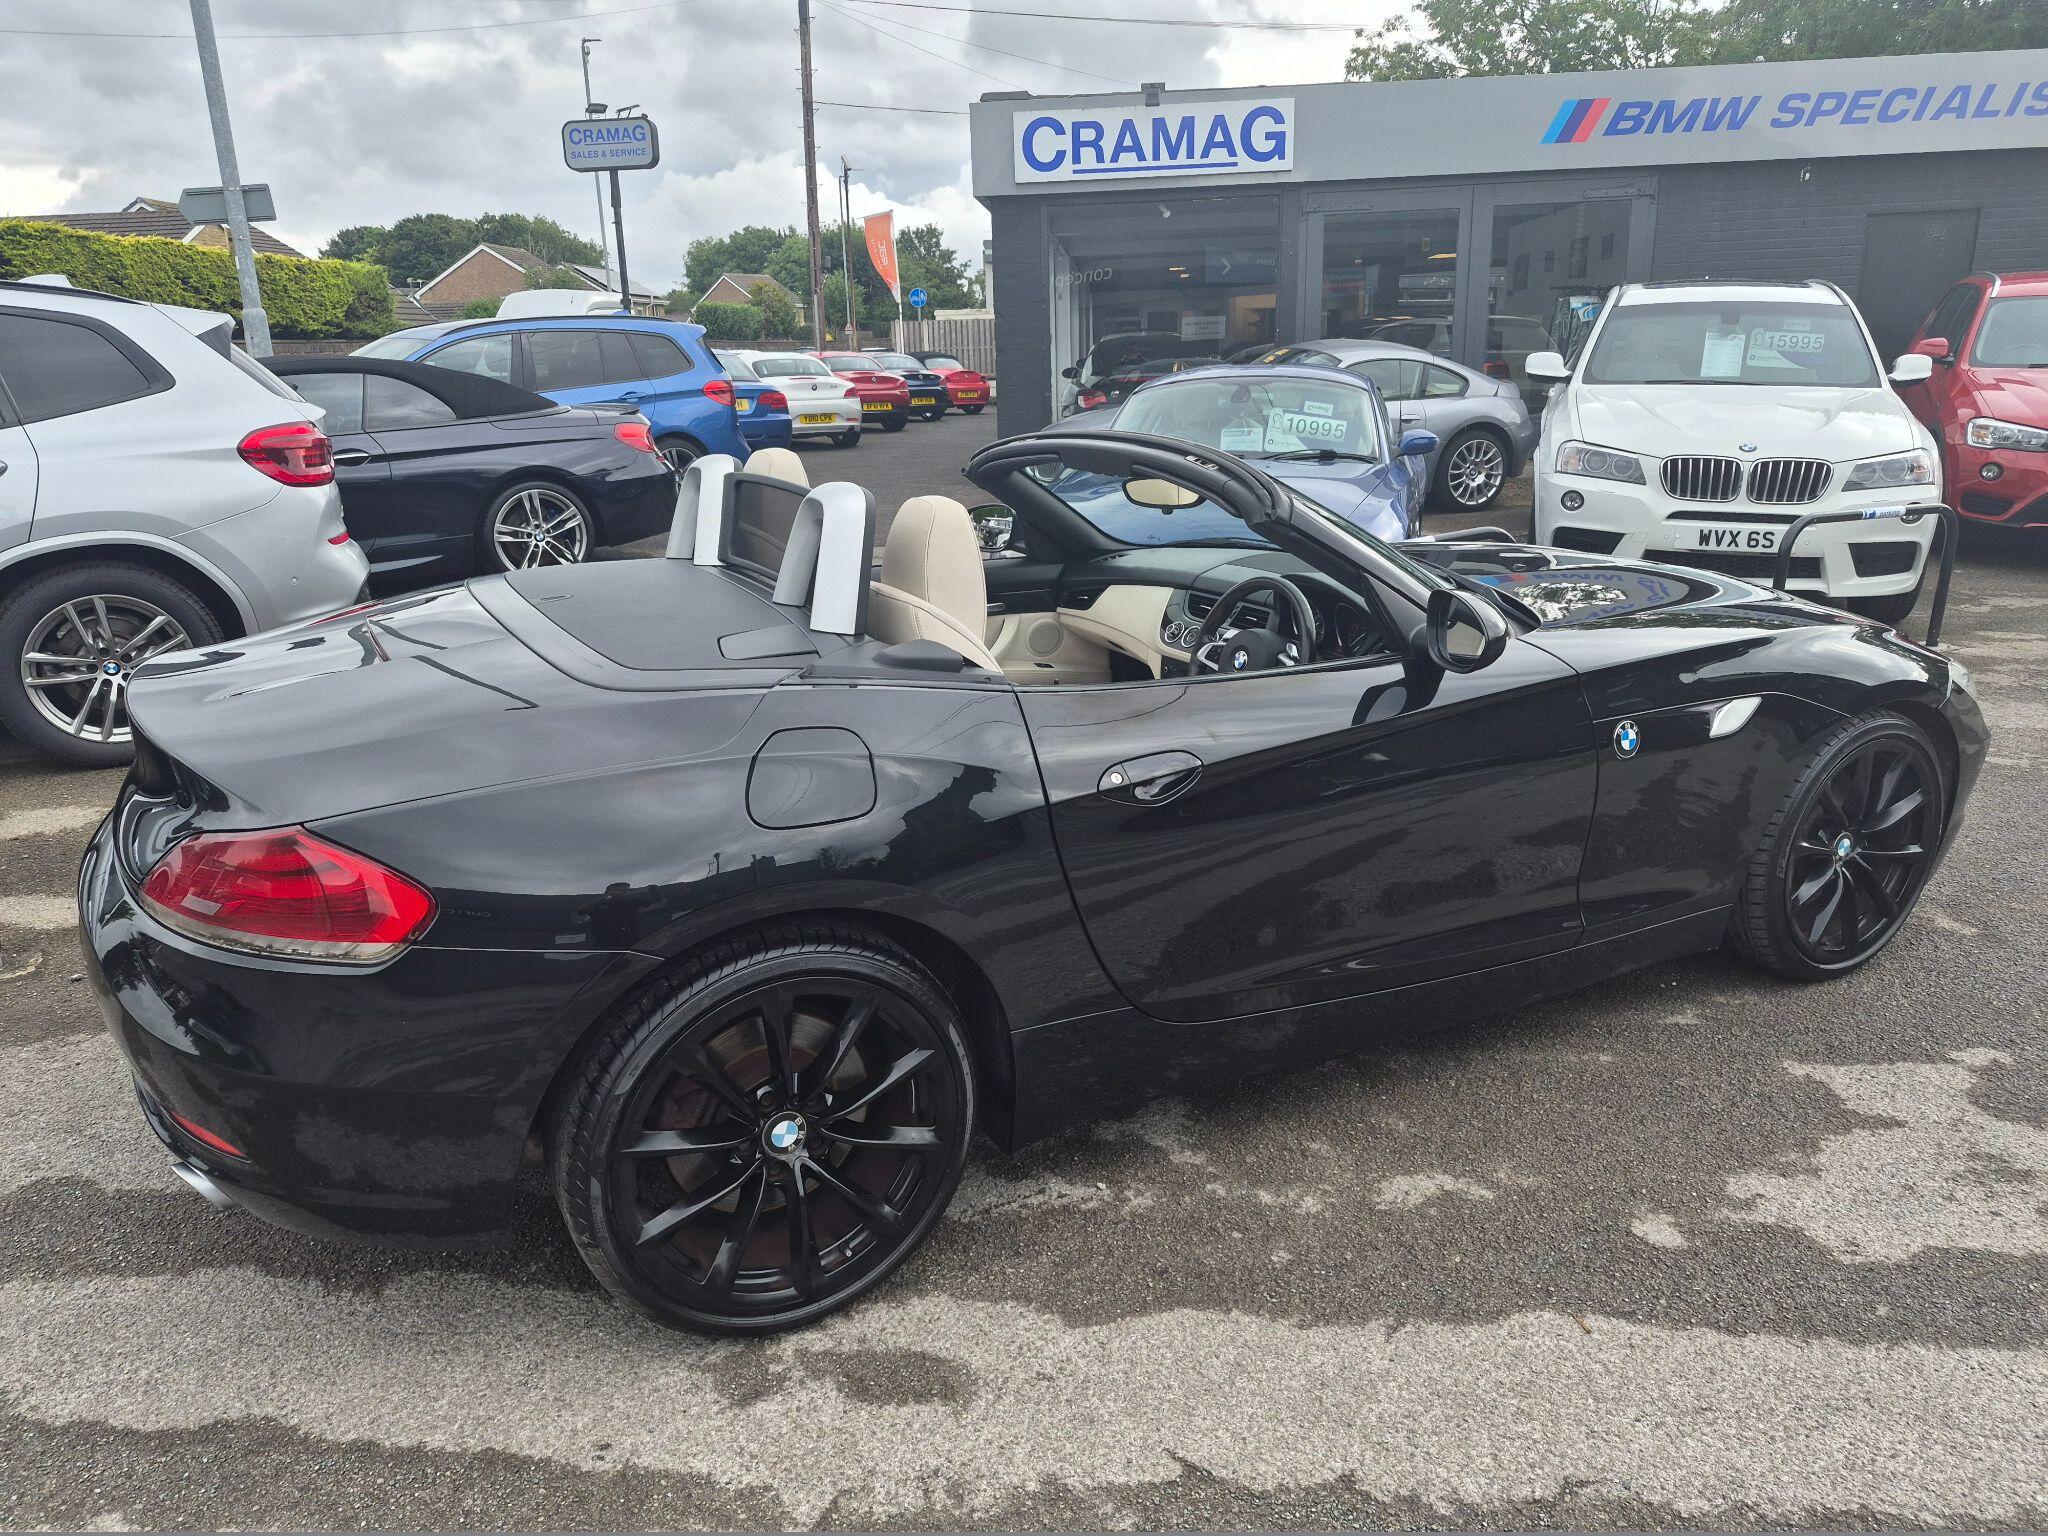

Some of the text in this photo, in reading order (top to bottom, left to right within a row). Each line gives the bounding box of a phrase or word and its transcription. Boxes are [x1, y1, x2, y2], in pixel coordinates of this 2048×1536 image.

[1603, 82, 2048, 136] BMW SPECIALIS
[569, 125, 646, 145] CRAMAG
[1022, 106, 1286, 172] CRAMAG
[571, 151, 599, 159] SALES
[609, 148, 647, 157] SERVICE
[1698, 529, 1776, 549] WVX 6S
